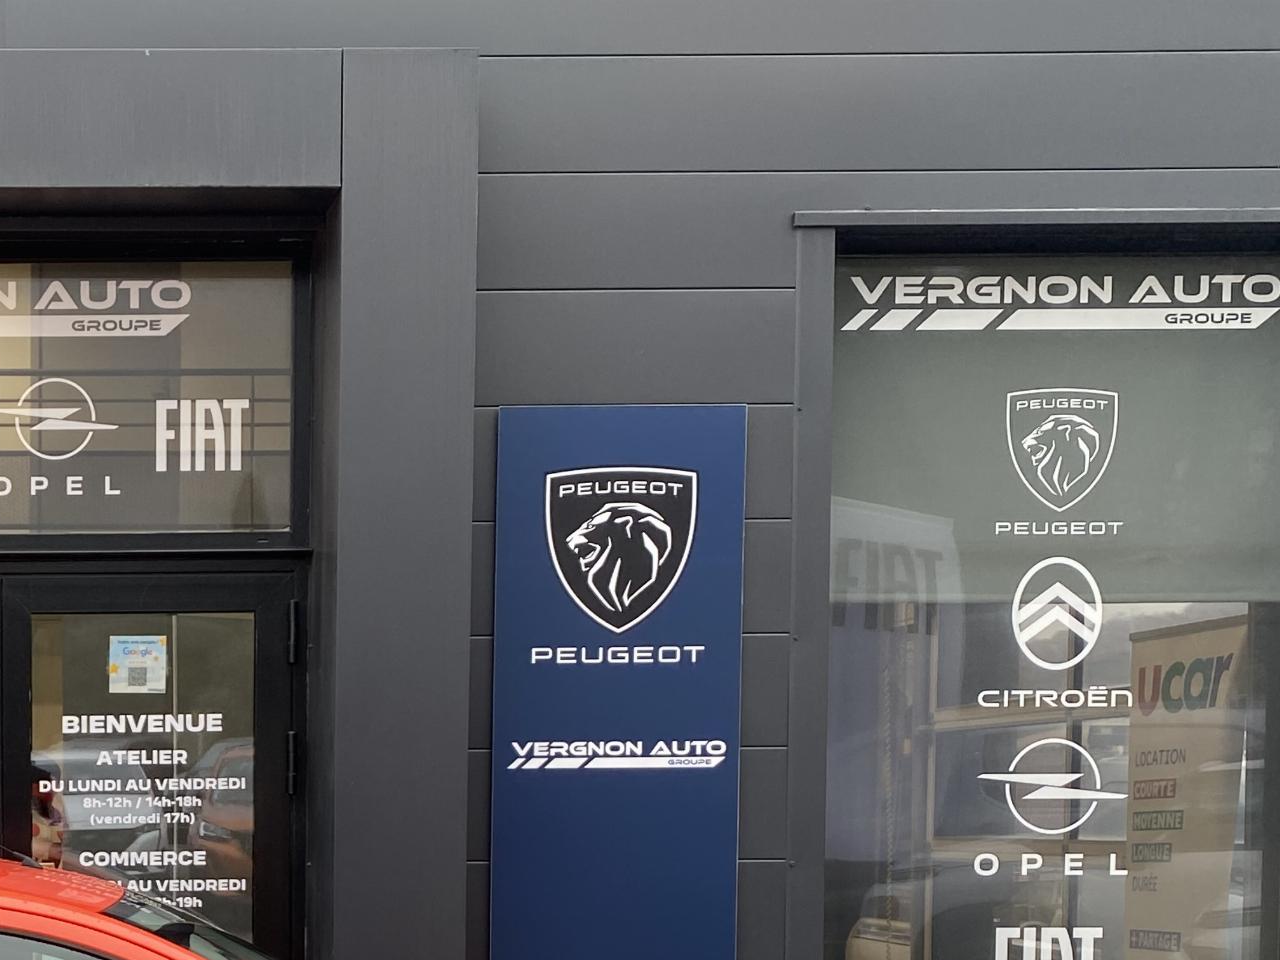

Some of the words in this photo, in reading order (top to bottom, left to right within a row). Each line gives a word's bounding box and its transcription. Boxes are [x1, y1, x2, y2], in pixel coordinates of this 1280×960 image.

[32, 279, 192, 310] AUTO
[850, 275, 1113, 305] VERGNON
[1128, 274, 1280, 304] AUTO
[71, 319, 162, 332] GROUPE
[1164, 312, 1252, 324] GROUPE
[1016, 398, 1109, 411] PEUGEOT
[154, 398, 250, 472] FIAT
[559, 480, 684, 498] PEUGEOT
[995, 521, 1124, 535] PEUGEOT
[531, 645, 705, 664] PEUGEOT
[1138, 653, 1234, 716] ucar
[61, 713, 223, 734] BIENVENUE
[511, 740, 643, 757] VERGNON
[649, 740, 727, 756] AUTO
[96, 749, 188, 766] ATELIER
[667, 758, 712, 766] GROUPE
[1135, 749, 1186, 767] LOCATION
[38, 780, 65, 793] DU
[68, 779, 122, 792] LUNDI
[125, 778, 152, 792] AU
[155, 777, 246, 791] VENDREDI
[1134, 782, 1176, 799] COURTE
[82, 796, 132, 809] 8h-12h
[145, 796, 202, 808] 14h-18h
[89, 812, 161, 826] (vendredi
[163, 811, 196, 825] 17h)
[78, 851, 207, 867] COMMERCE
[973, 853, 1129, 876] OPEL
[126, 879, 153, 893] AU
[156, 878, 246, 891] VENDREDI
